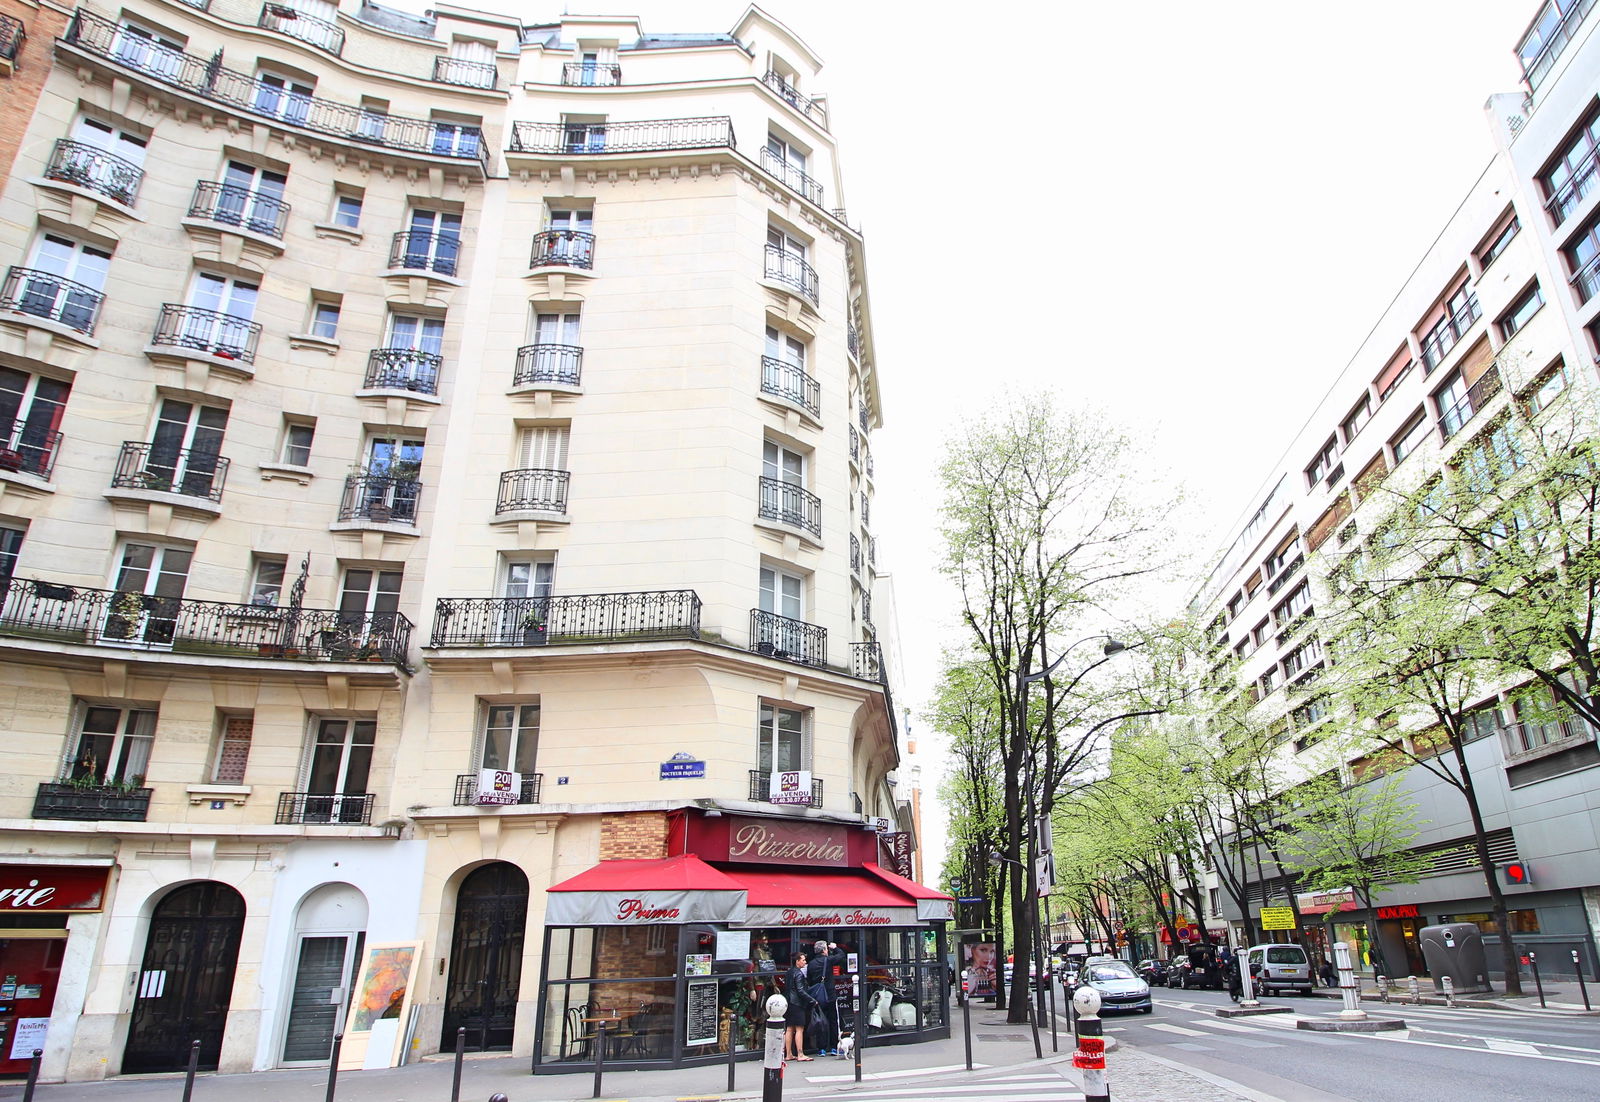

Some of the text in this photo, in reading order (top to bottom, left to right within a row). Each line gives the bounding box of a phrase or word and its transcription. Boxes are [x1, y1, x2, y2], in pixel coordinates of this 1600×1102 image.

[496, 791, 519, 799] VENDU
[730, 824, 845, 862] Pizzeria
[617, 899, 680, 920] Prima
[781, 909, 891, 926] Ristorante Italiano
[1377, 905, 1418, 919] MONOPRIX
